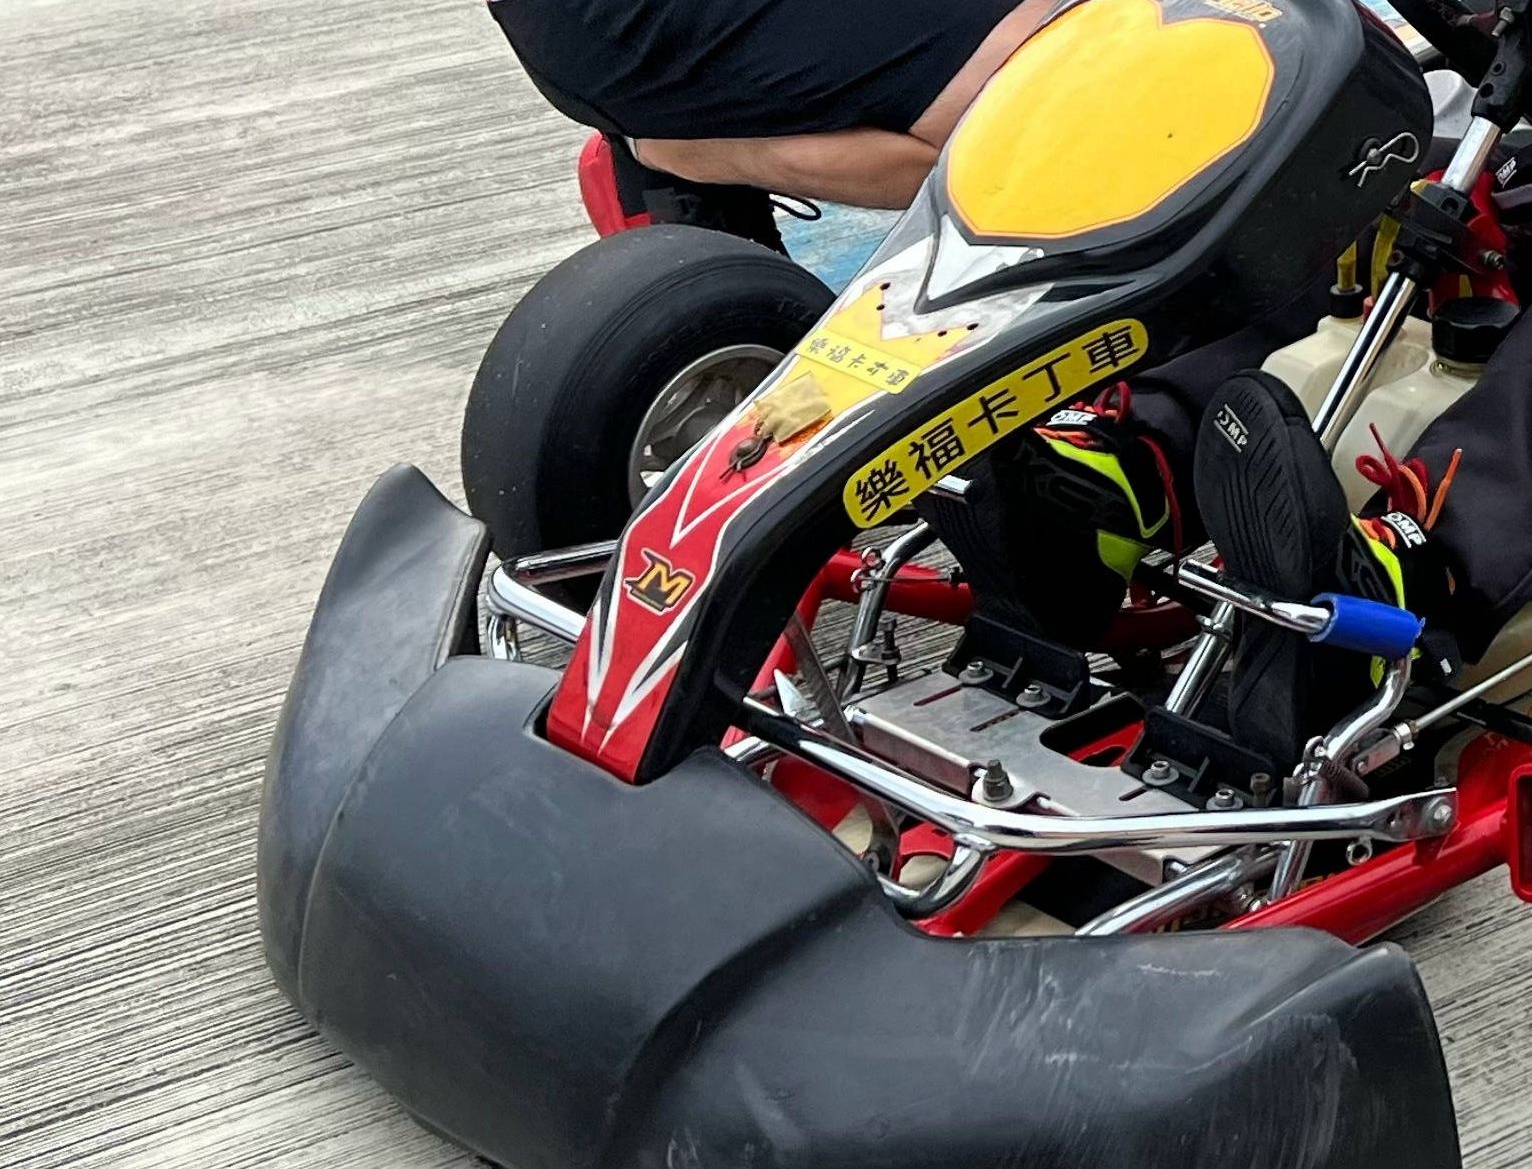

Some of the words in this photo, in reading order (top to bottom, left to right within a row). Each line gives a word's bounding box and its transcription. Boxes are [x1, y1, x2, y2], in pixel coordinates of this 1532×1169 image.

[855, 325, 1140, 521] 樂福卡丁車
